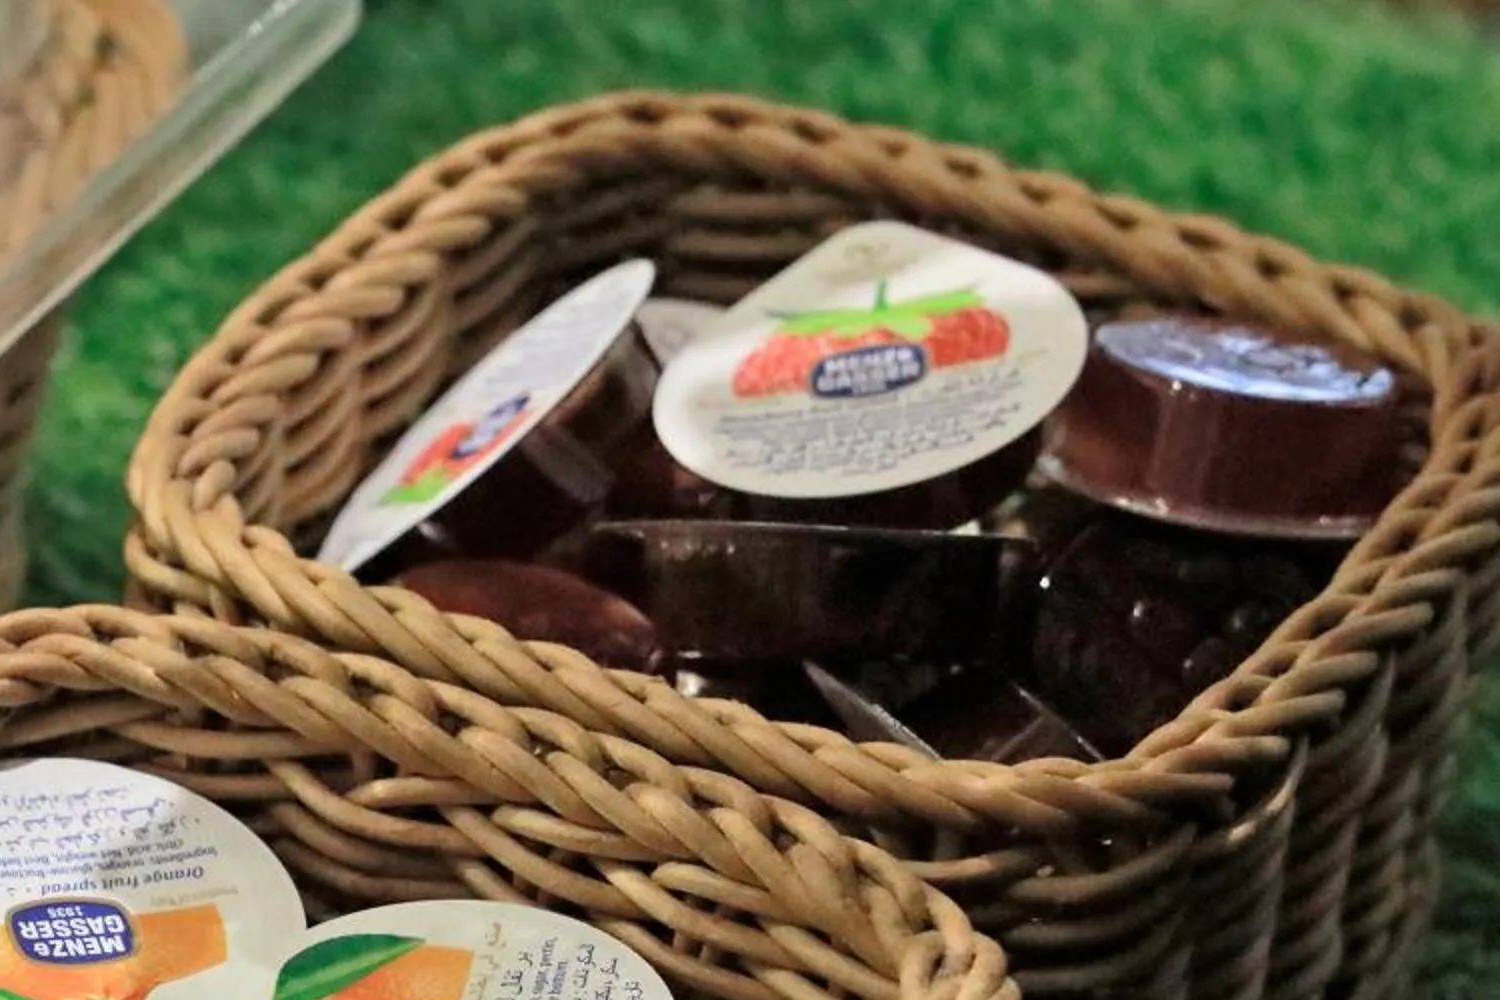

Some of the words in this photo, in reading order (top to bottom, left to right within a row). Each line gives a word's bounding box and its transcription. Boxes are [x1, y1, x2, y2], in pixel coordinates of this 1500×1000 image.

[101, 876, 139, 890] fruit
[143, 866, 204, 884] Orange
[41, 878, 97, 896] spread
[18, 915, 125, 939] GASSER
[34, 935, 125, 957] MENZ&
